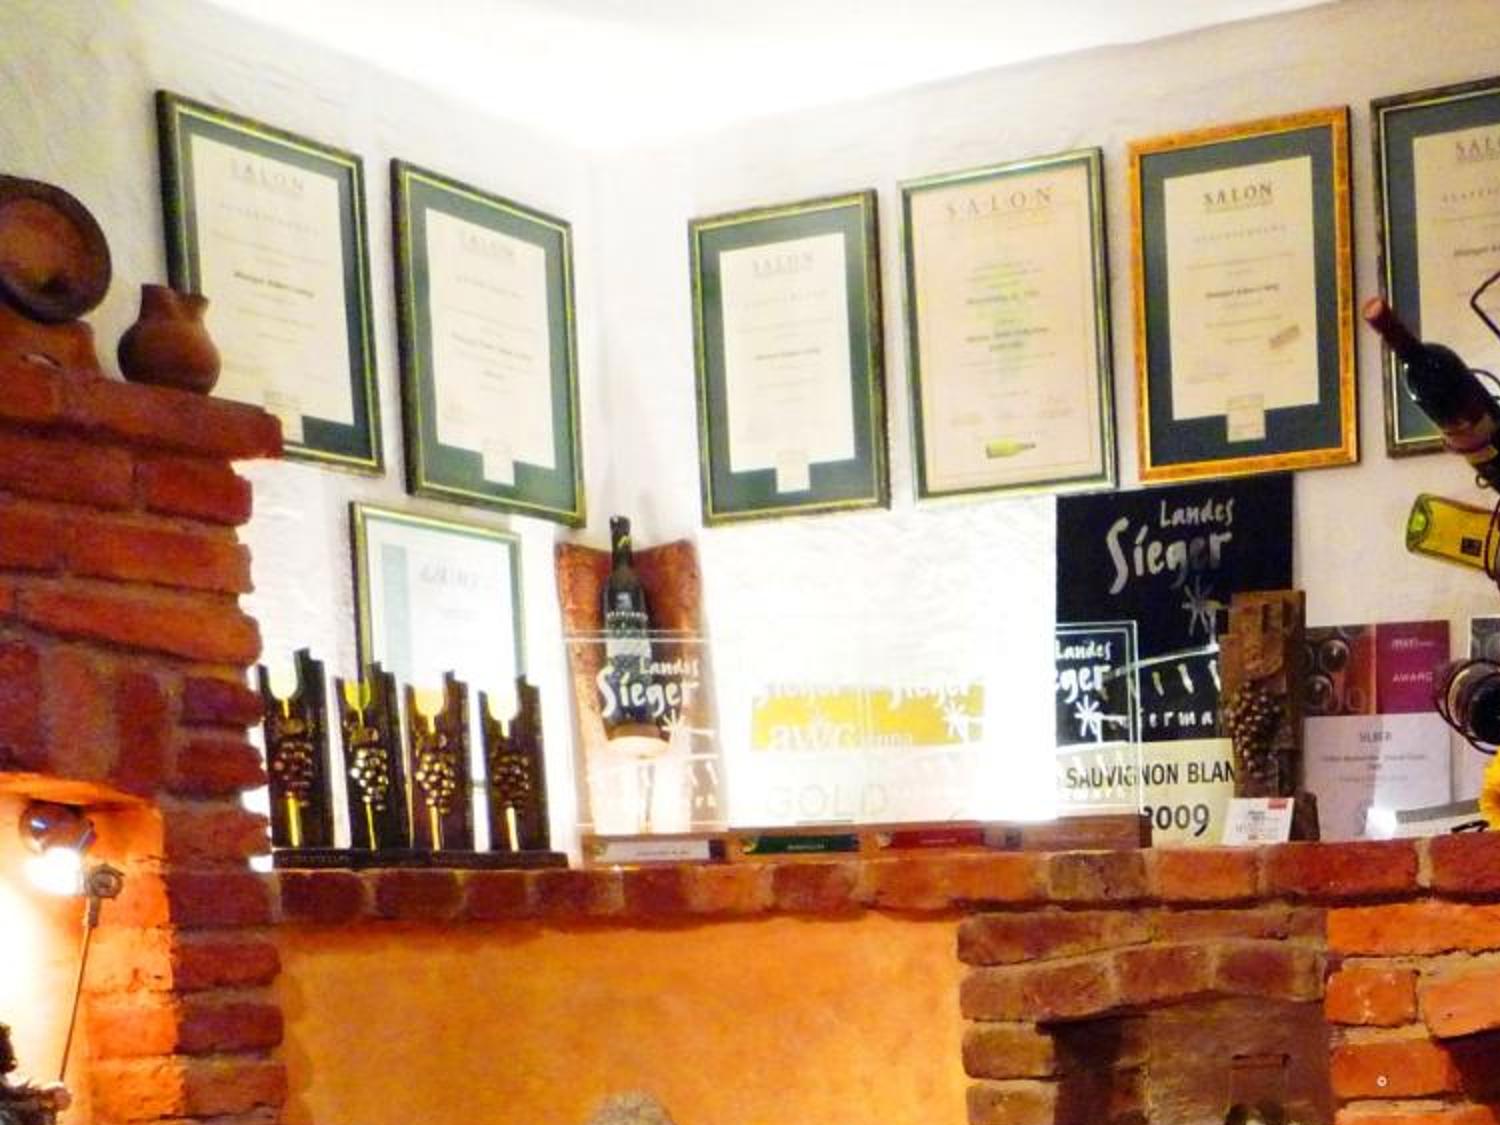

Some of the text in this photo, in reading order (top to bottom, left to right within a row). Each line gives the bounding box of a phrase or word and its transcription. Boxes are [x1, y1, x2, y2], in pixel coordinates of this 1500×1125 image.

[946, 186, 1052, 221] SALON
[1202, 180, 1273, 207] SALON
[1160, 499, 1234, 529] Landes
[1105, 516, 1233, 595] Sieger
[596, 664, 702, 719] Sieger
[1066, 760, 1236, 790] SAUVIGNON BLAN
